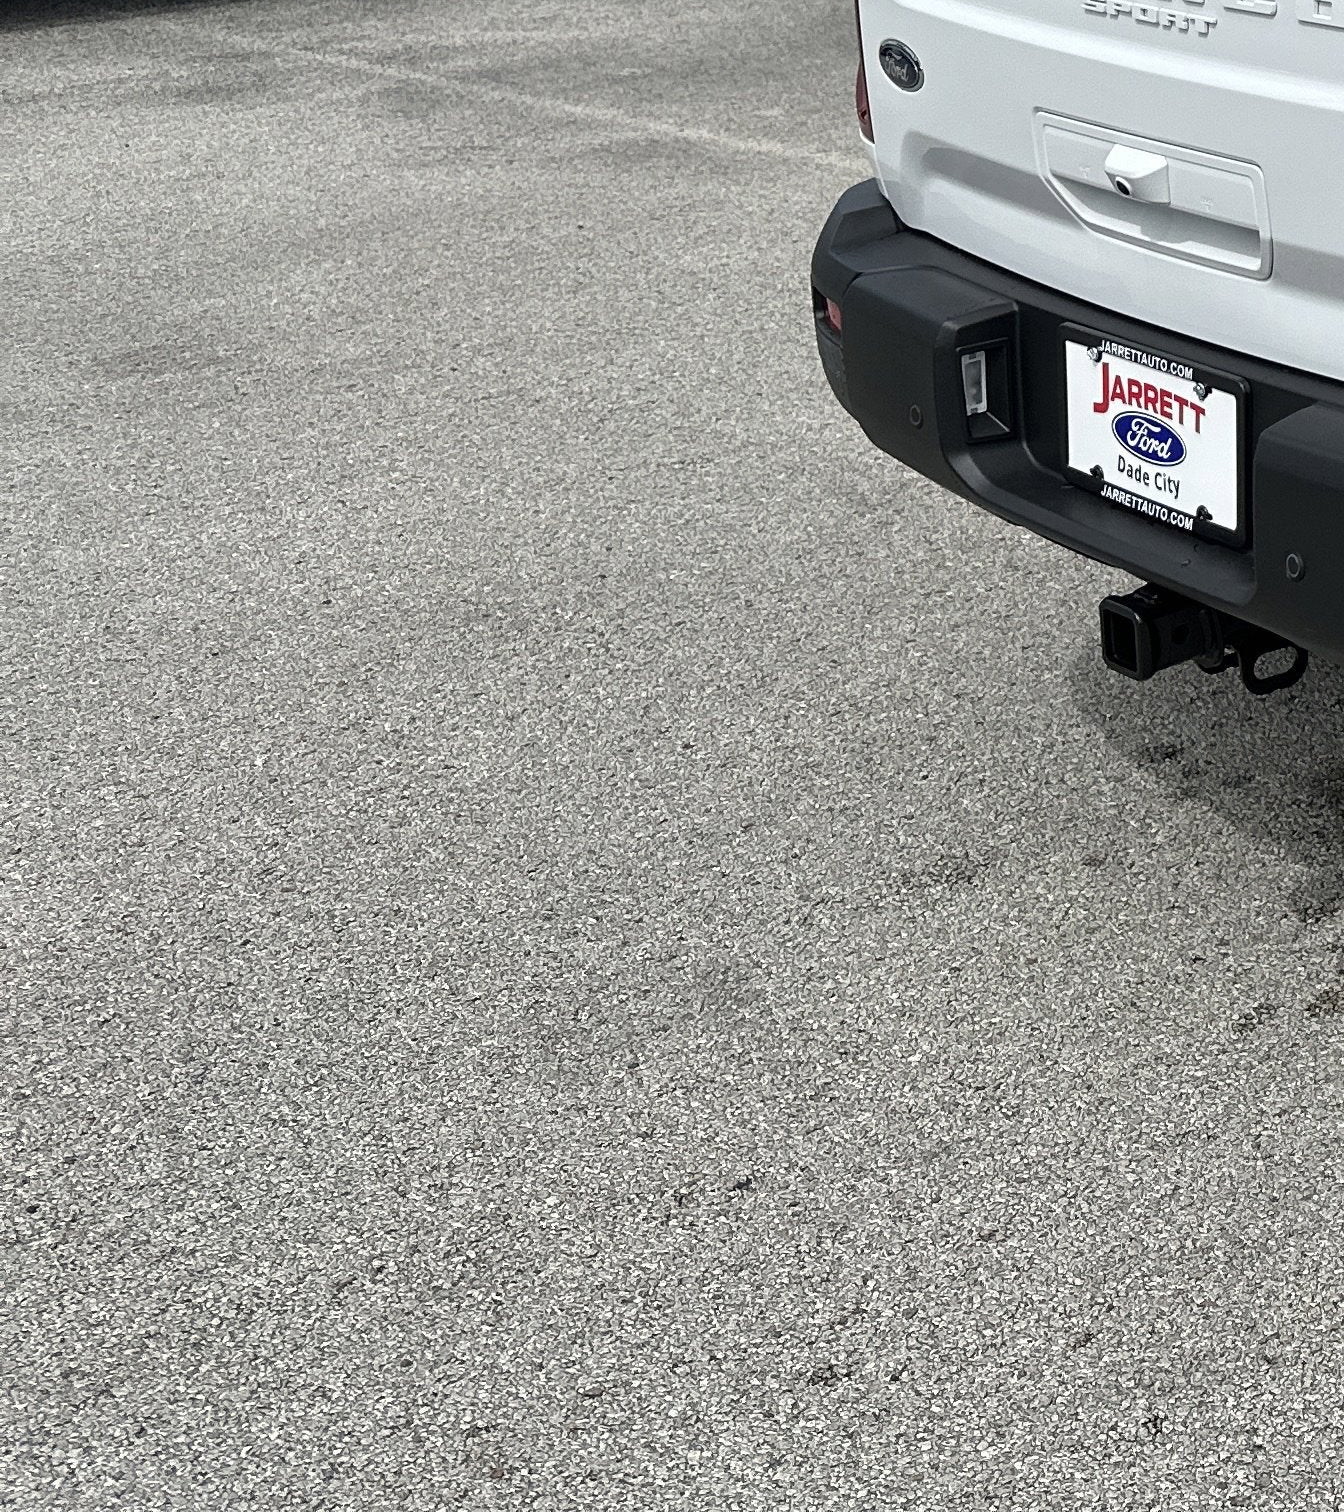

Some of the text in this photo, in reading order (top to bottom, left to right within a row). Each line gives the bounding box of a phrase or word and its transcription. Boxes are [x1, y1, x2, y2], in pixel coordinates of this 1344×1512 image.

[884, 49, 909, 83] Ford
[1100, 340, 1193, 380] JARRETTAUTO.COM
[1093, 361, 1206, 434] JARRETT
[1126, 418, 1174, 460] Ford
[1117, 454, 1180, 499] Dade City
[1100, 484, 1194, 531] JARRETTAUTO.COM
